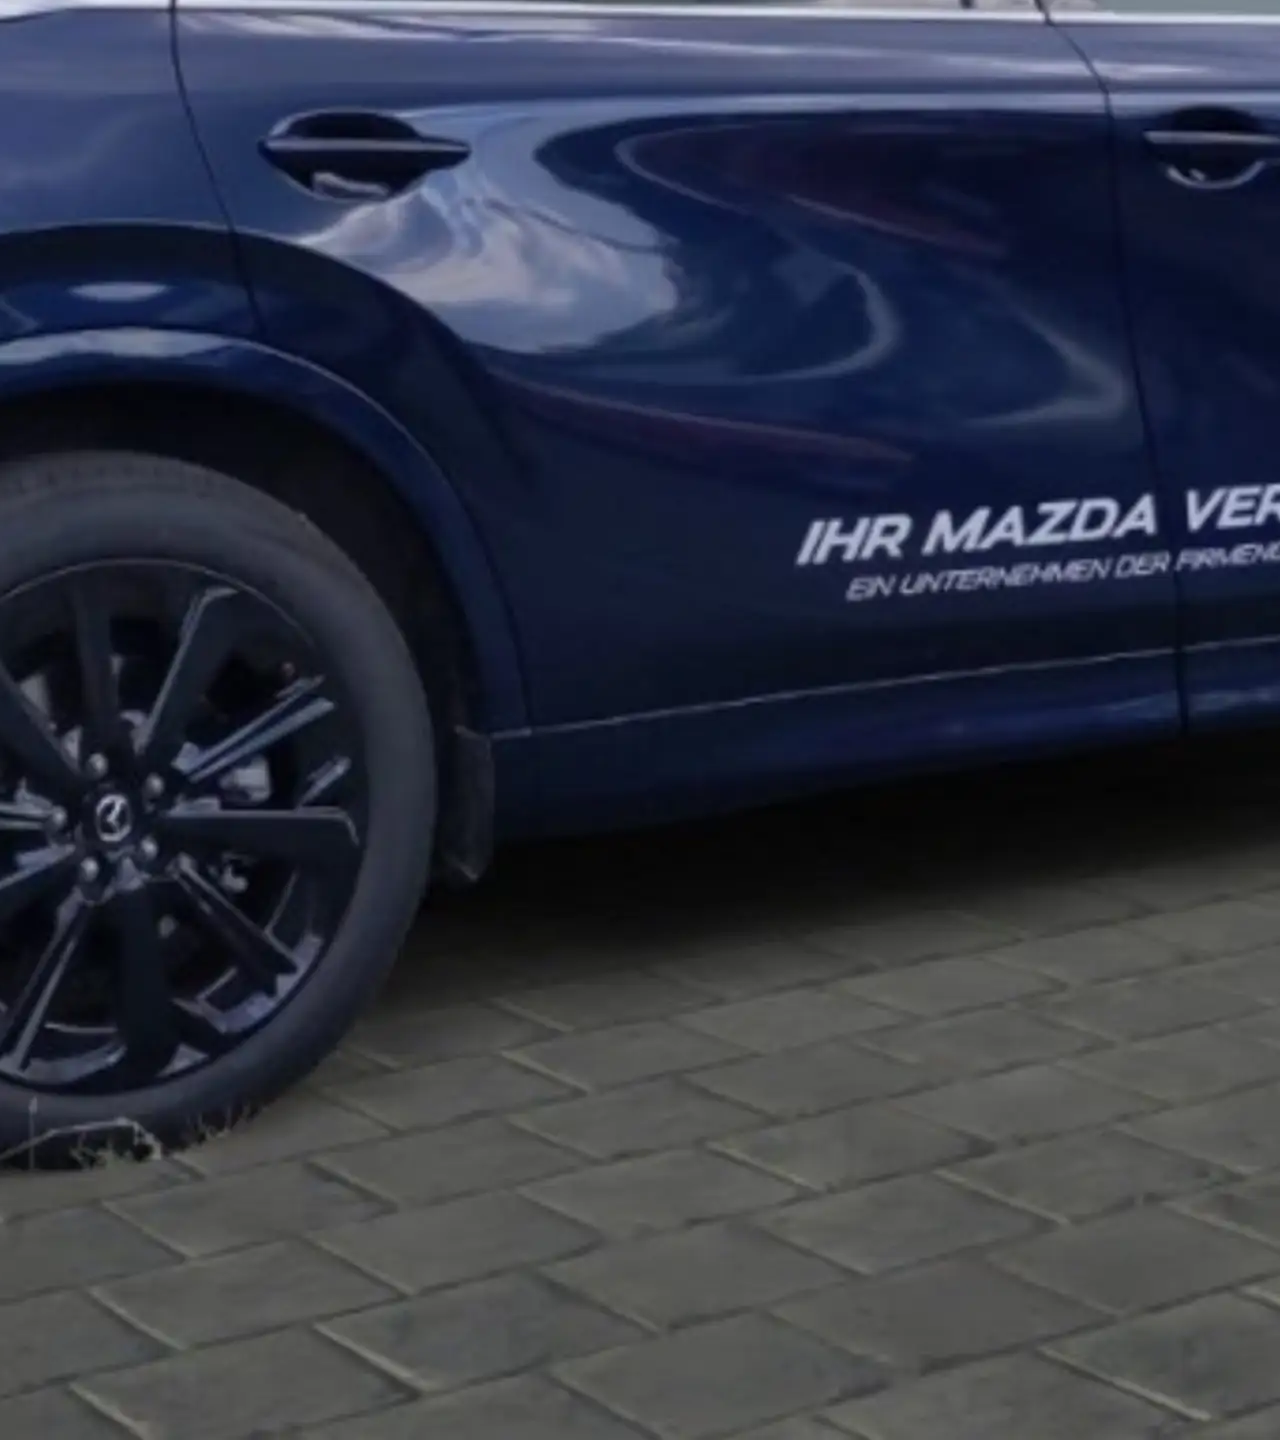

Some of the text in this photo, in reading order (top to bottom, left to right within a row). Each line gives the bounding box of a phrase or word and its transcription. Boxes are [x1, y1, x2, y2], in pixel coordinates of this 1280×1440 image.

[794, 513, 913, 567] IHR
[921, 493, 1158, 556] MAZDA
[845, 573, 896, 602] EIN
[898, 558, 1112, 596] UNTERNEHMEN
[1114, 550, 1172, 580] DER
